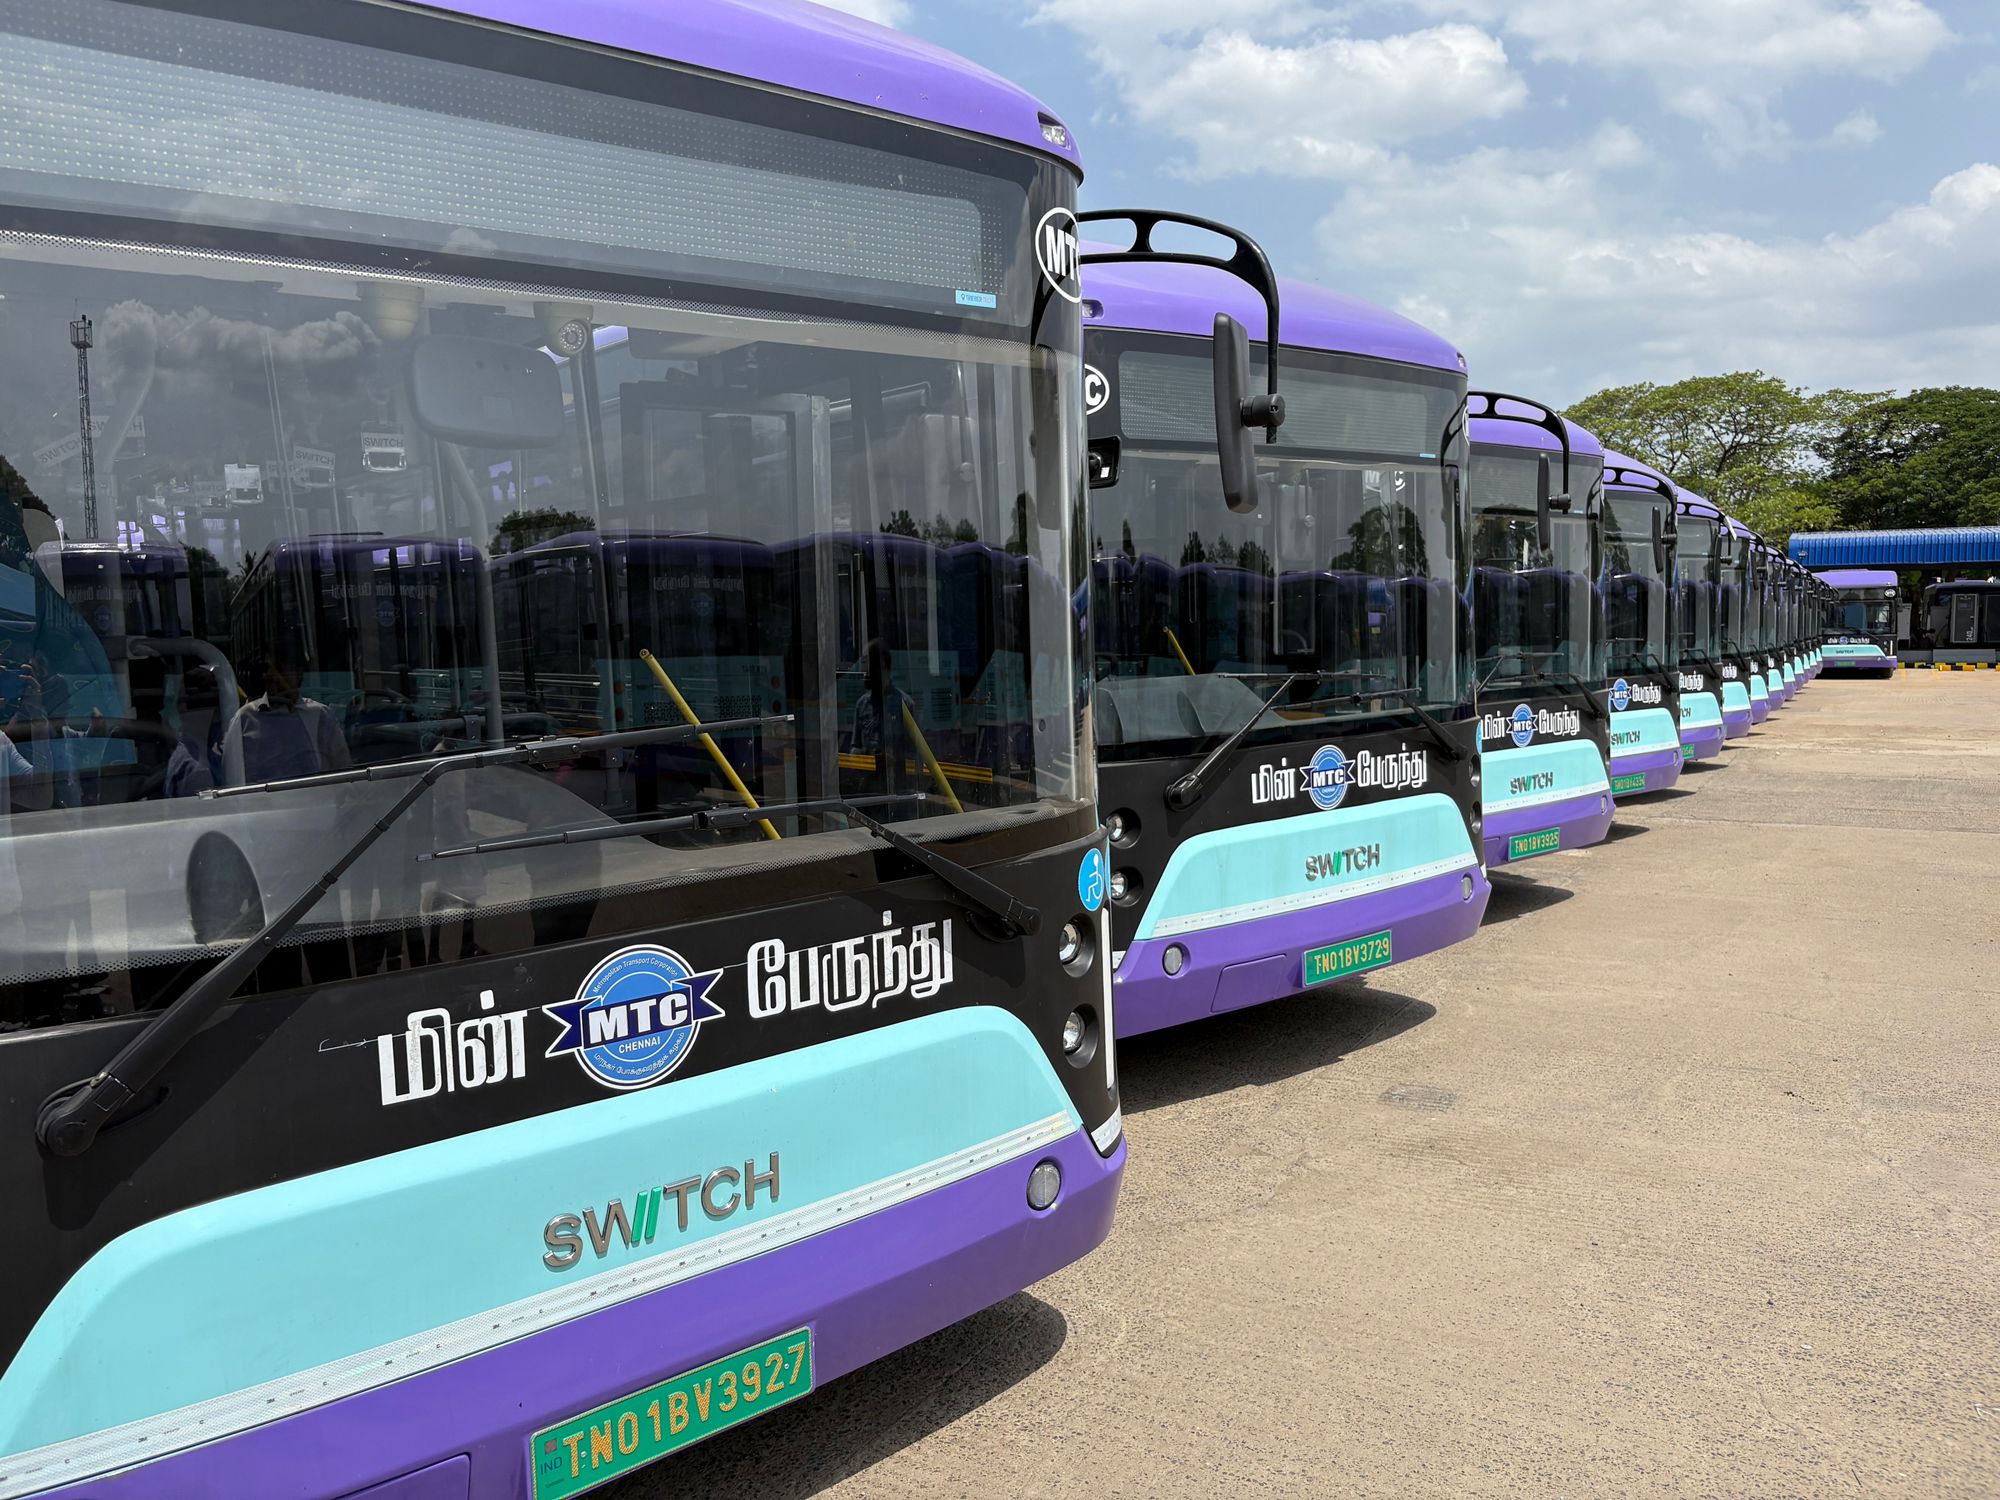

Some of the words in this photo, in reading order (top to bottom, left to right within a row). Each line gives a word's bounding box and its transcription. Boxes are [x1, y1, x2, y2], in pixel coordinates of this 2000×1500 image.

[1045, 224, 1080, 281] MT
[364, 437, 404, 449] SWITCH
[1513, 720, 1532, 731] MTC
[1539, 704, 1580, 736] பேருந்து
[1251, 757, 1296, 804] மின்
[1313, 768, 1344, 788] MTC
[1357, 743, 1427, 791] பேருந்து
[1510, 772, 1553, 794] SWITCH
[1305, 843, 1380, 882] SWITCH
[593, 965, 622, 993] Metropolitan
[623, 957, 650, 968] Transport
[650, 957, 679, 977] Corporation
[748, 911, 953, 1020] பேருந்து
[1314, 937, 1390, 975] TN01BV3729
[588, 993, 688, 1044] MTC
[377, 989, 527, 1105] மின்
[618, 1036, 661, 1054] CHENNAI
[543, 1152, 779, 1267] SWITCH
[562, 1341, 806, 1478] TN01BV3927
[540, 1455, 563, 1476] IND
